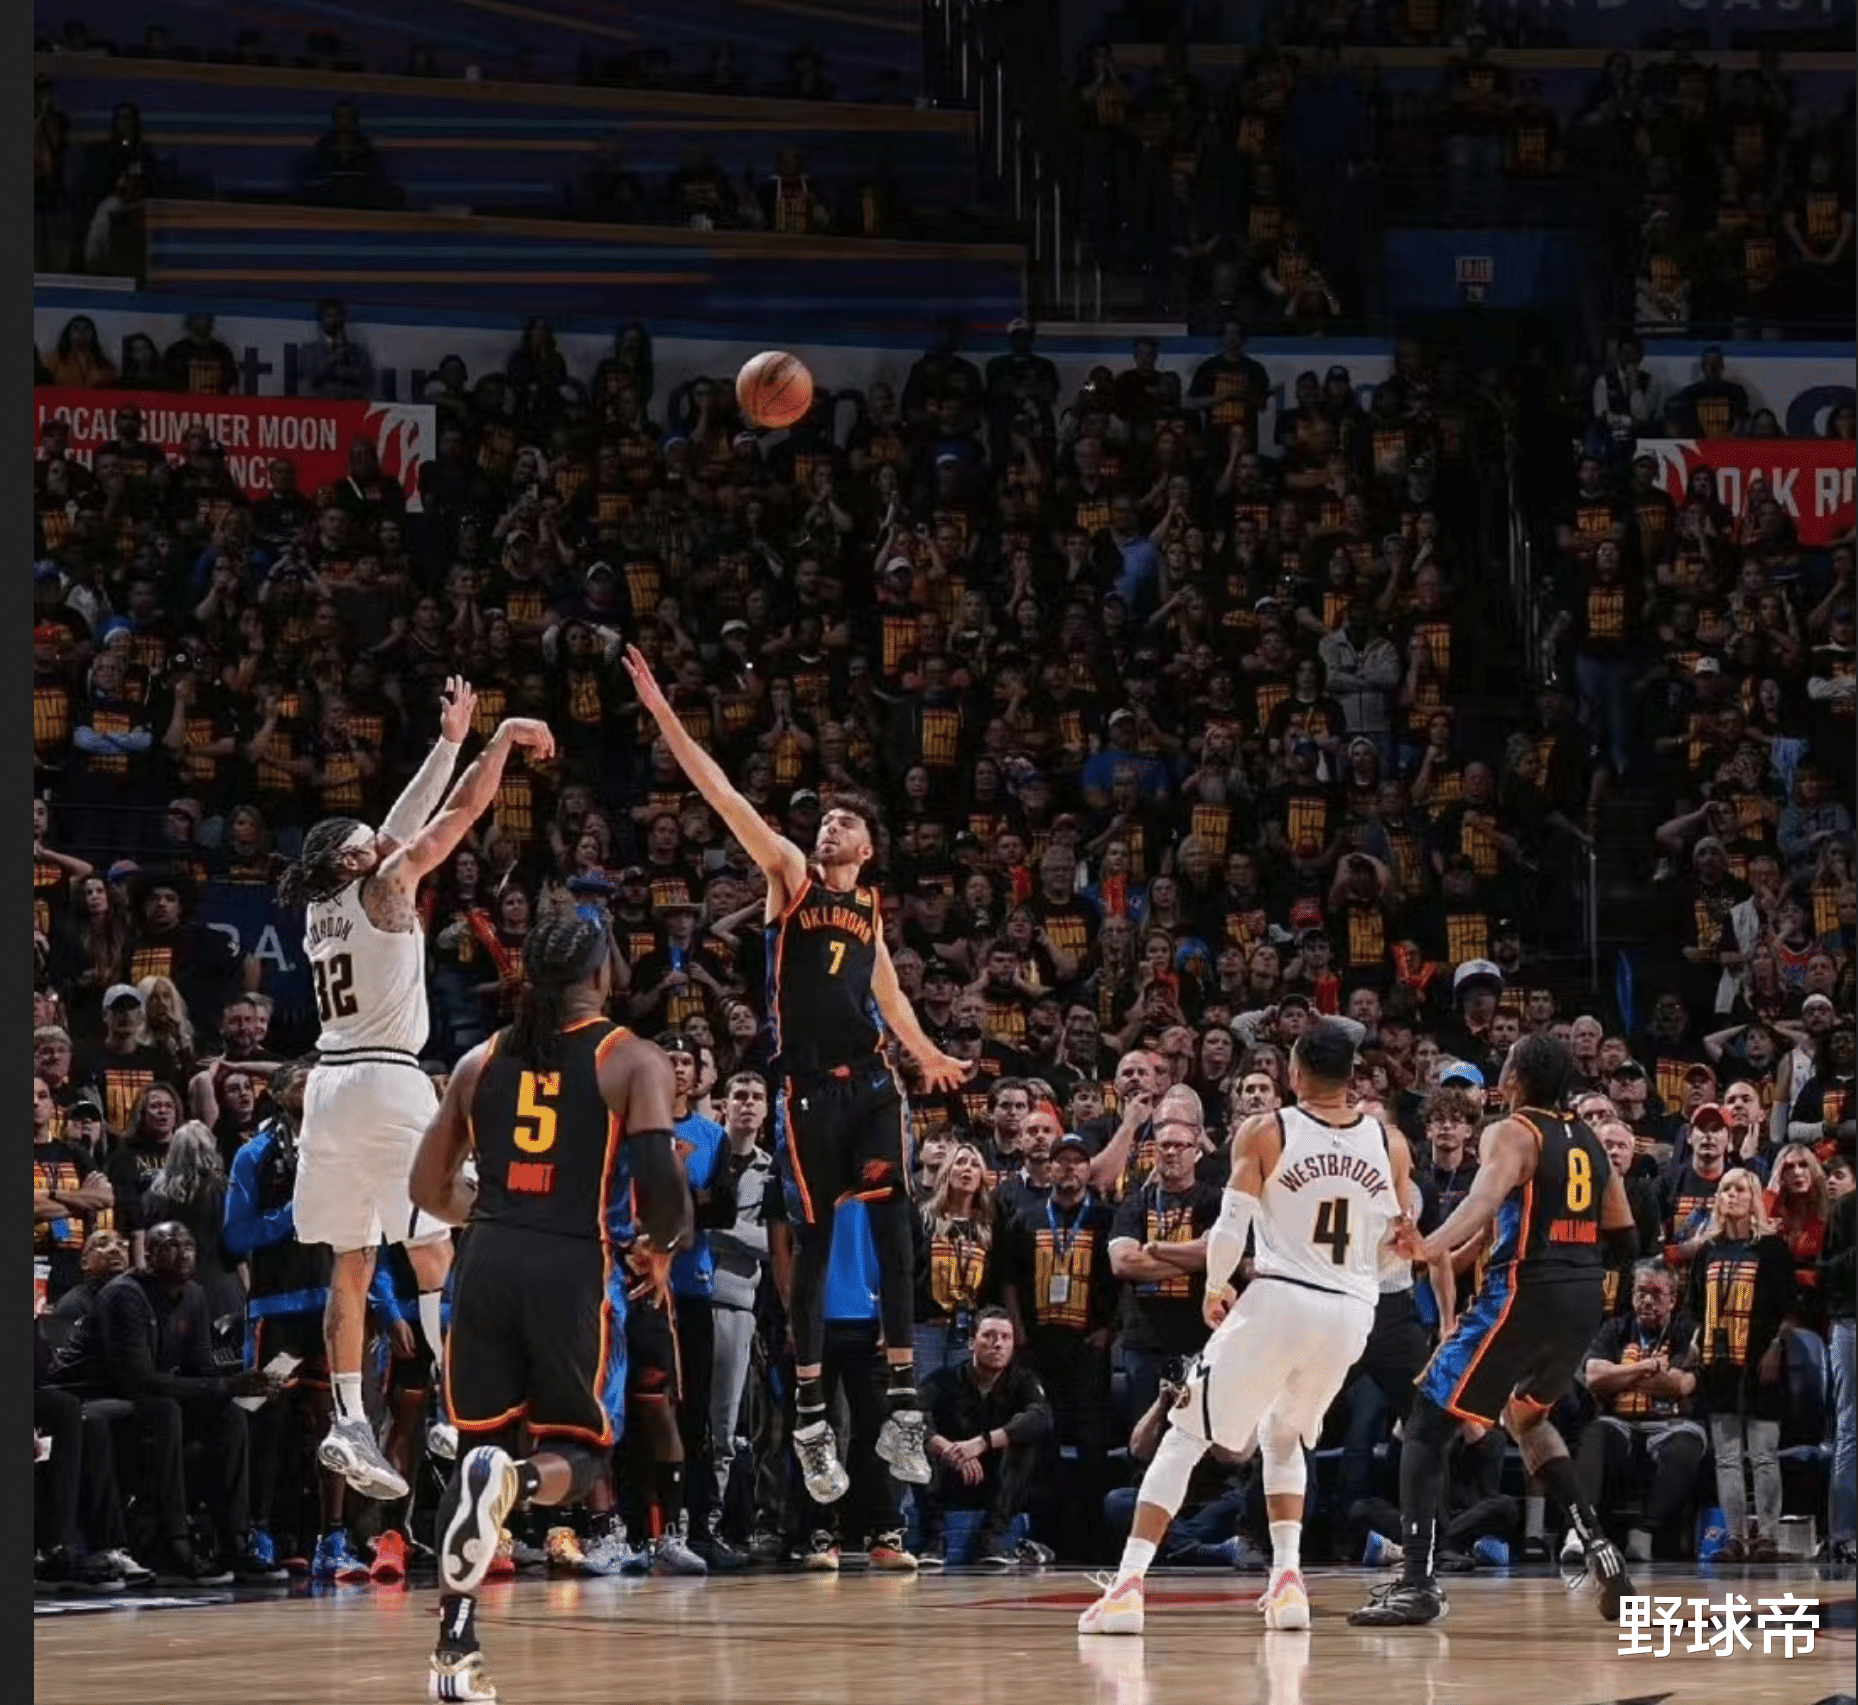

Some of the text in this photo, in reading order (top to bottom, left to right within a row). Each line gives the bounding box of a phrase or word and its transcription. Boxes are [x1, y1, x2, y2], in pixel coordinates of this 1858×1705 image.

[258, 415, 337, 451] MOON
[827, 940, 846, 975] 7
[512, 1070, 561, 1154] 5
[1278, 1152, 1389, 1198] WESTBROOK
[1566, 1147, 1592, 1212] 8
[1312, 1197, 1351, 1266] 4
